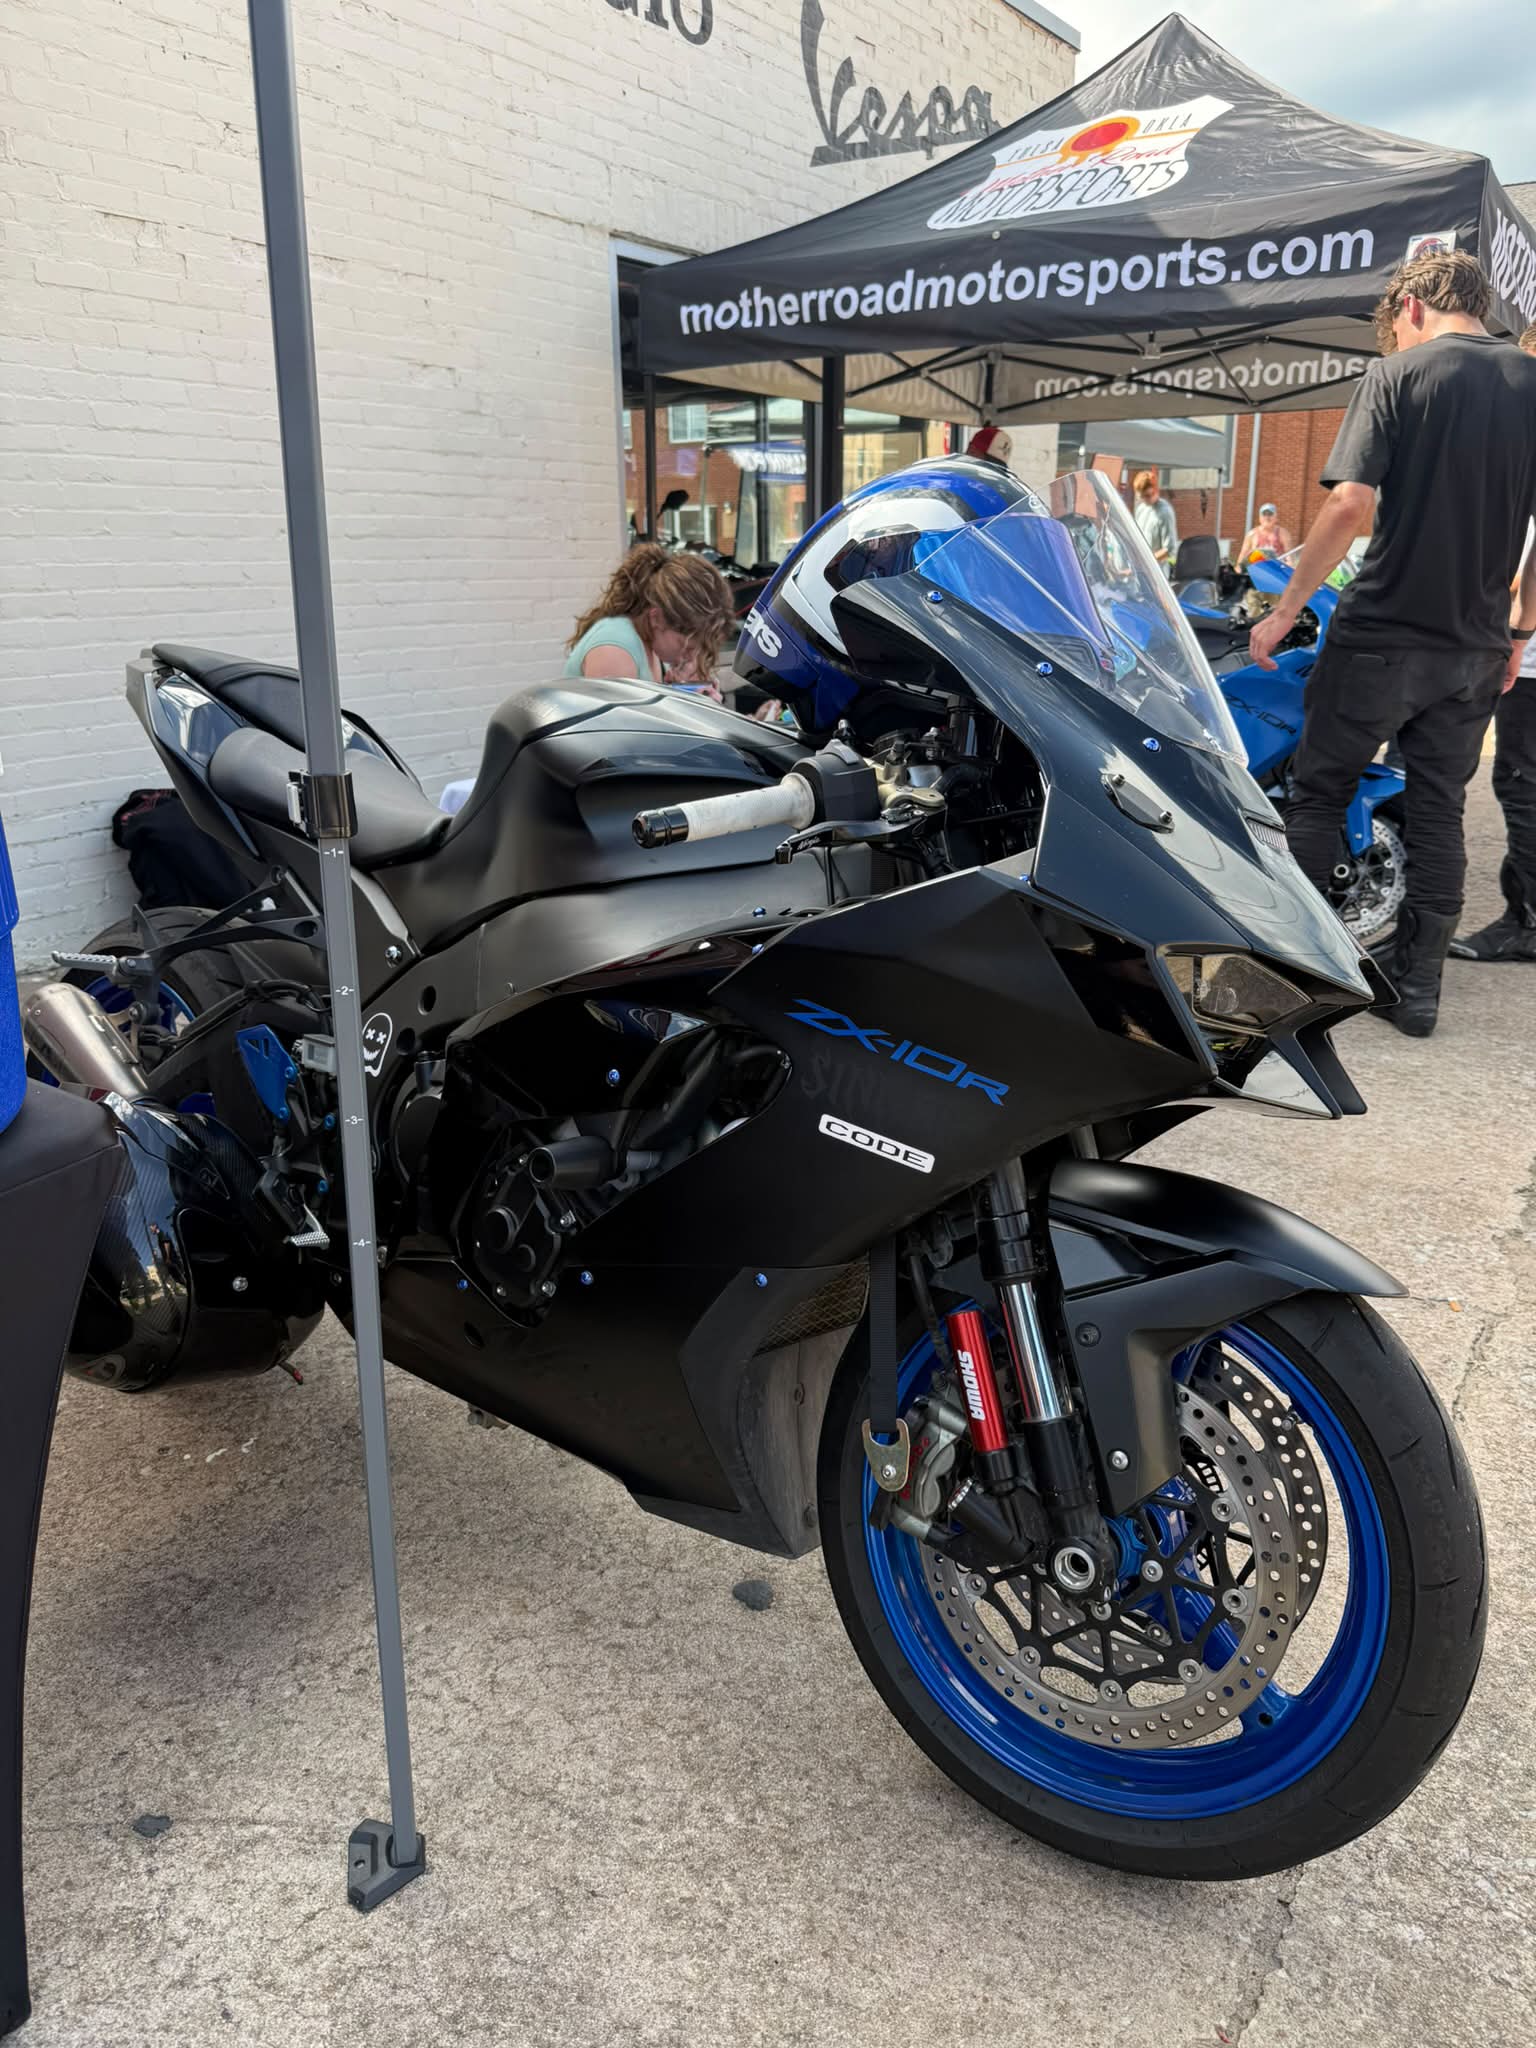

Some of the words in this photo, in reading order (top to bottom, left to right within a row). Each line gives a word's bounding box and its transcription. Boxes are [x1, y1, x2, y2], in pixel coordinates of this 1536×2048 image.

[801, 0, 1001, 167] Vespa
[1142, 113, 1193, 134] OKLA
[934, 158, 1186, 224] MOTORSPORTS
[680, 228, 1375, 335] motherroadmotorsports.com
[784, 998, 1011, 1107] ZX-10R
[825, 1120, 929, 1169] CODE
[957, 1349, 986, 1421] SHOWA
